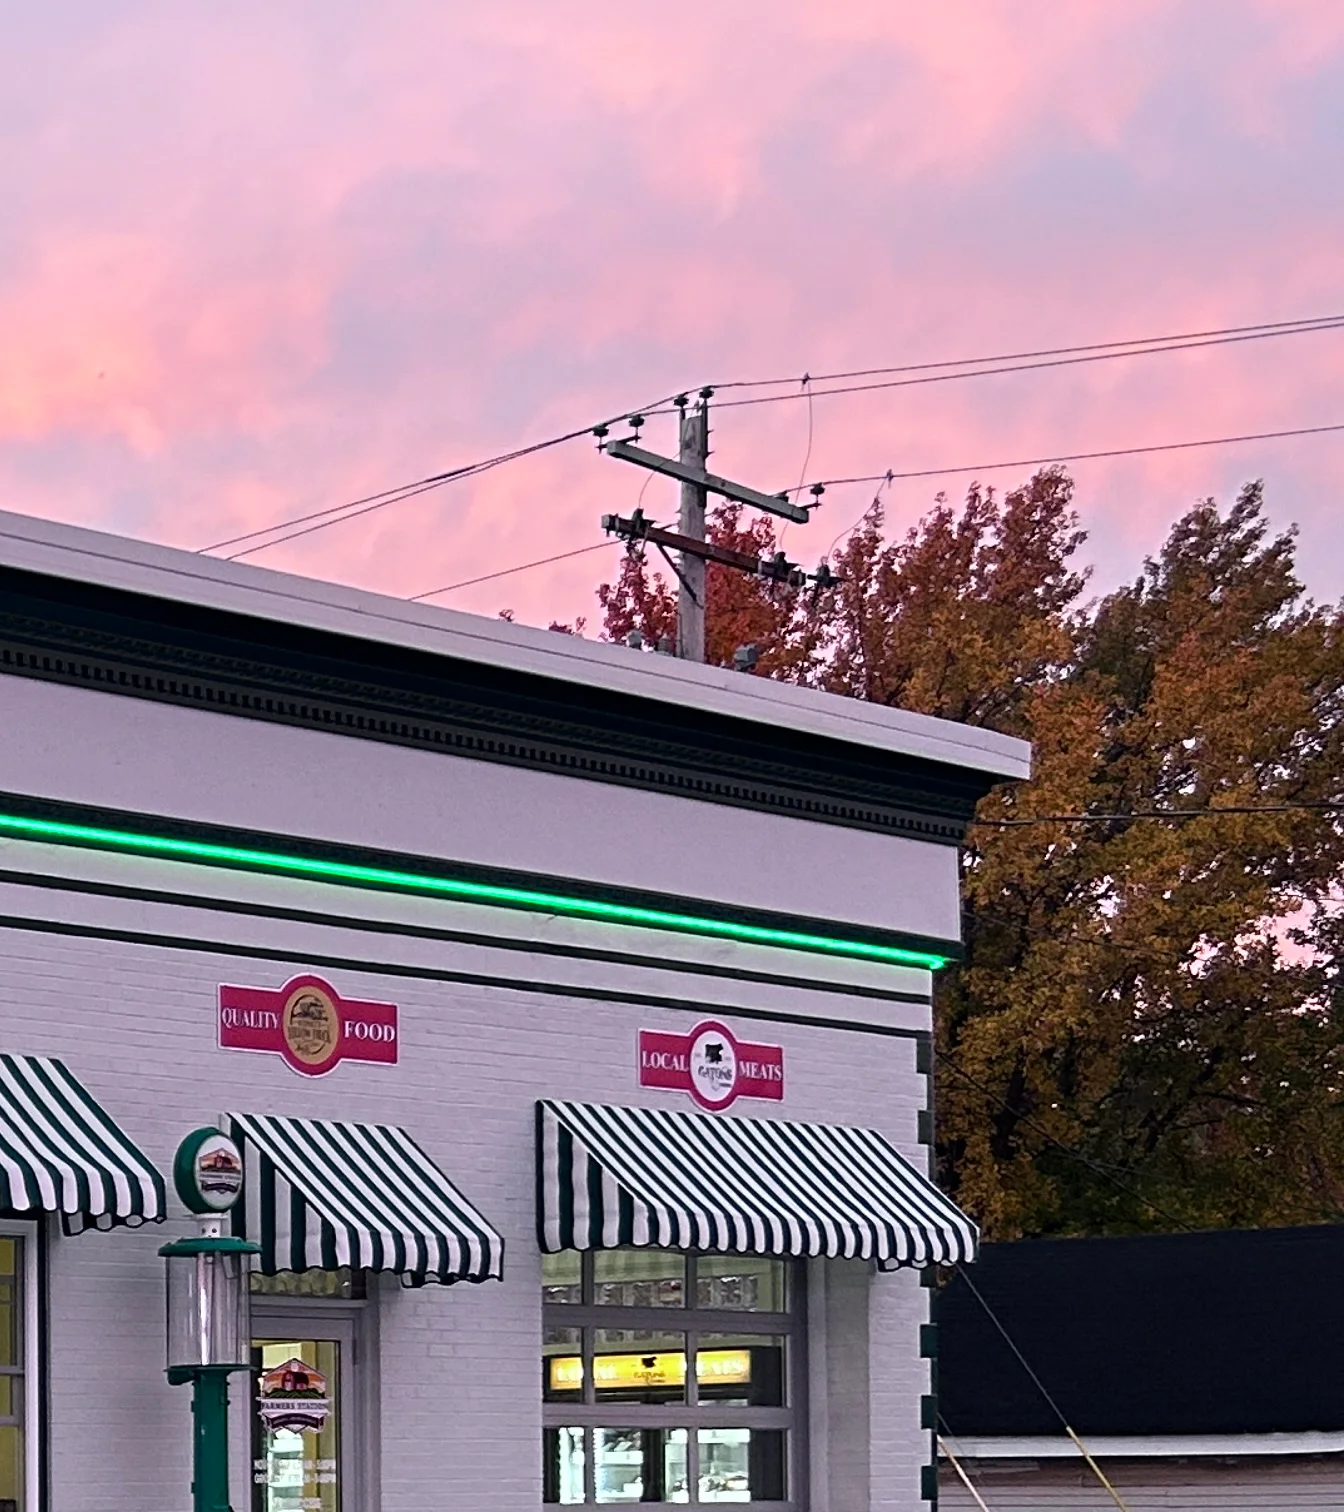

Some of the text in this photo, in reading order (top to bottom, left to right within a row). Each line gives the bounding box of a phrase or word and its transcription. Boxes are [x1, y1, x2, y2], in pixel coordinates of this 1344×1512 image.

[221, 1007, 280, 1029] QUALITY
[344, 1020, 395, 1042] FOOD
[642, 1051, 782, 1081] LOCAL MEATS
[261, 1402, 295, 1410] FARMERS
